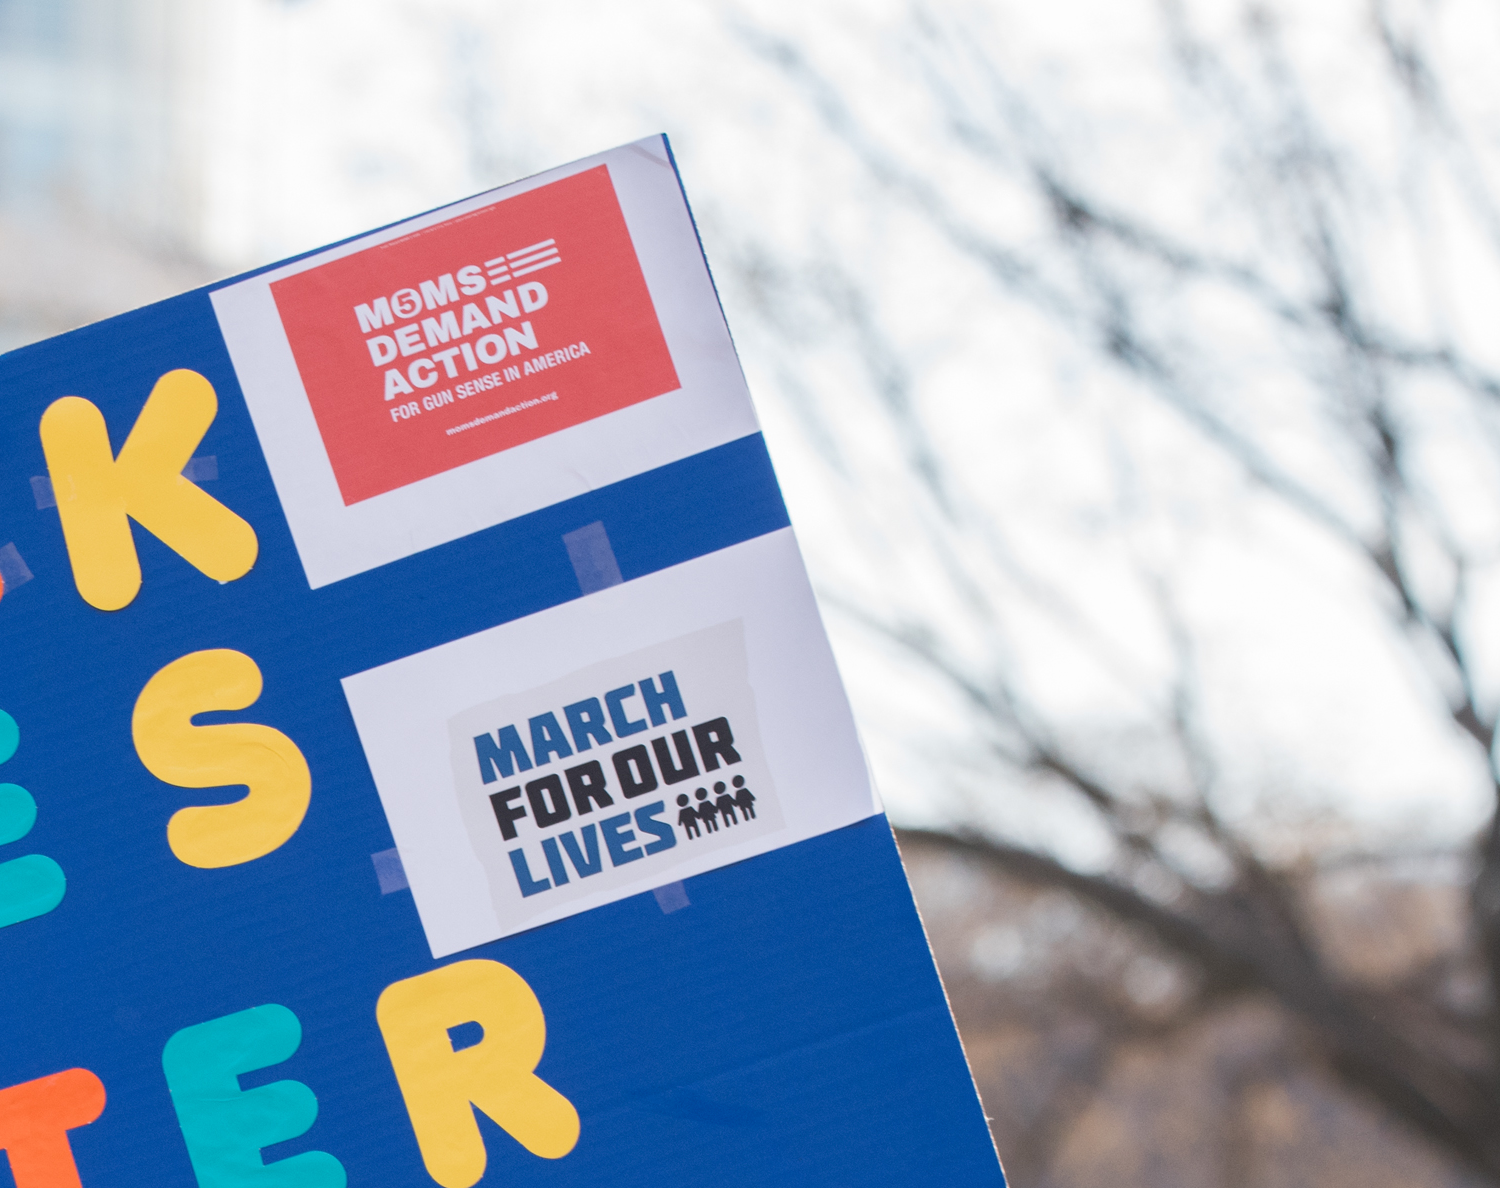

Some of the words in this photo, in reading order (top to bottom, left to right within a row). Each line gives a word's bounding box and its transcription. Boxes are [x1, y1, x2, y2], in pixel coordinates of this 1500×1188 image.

[365, 281, 549, 367] DEMAND
[384, 320, 539, 401] ACTION
[390, 401, 422, 422] FOR
[422, 389, 455, 411] GUN
[455, 371, 504, 399] SENSE
[503, 365, 522, 382] IN
[523, 341, 592, 376] AMERICA
[445, 391, 559, 436] momsdemandaction.org
[472, 669, 688, 785] MARCH
[488, 760, 614, 842] FOR
[611, 716, 742, 800] OUR
[507, 800, 678, 899] LIVES
